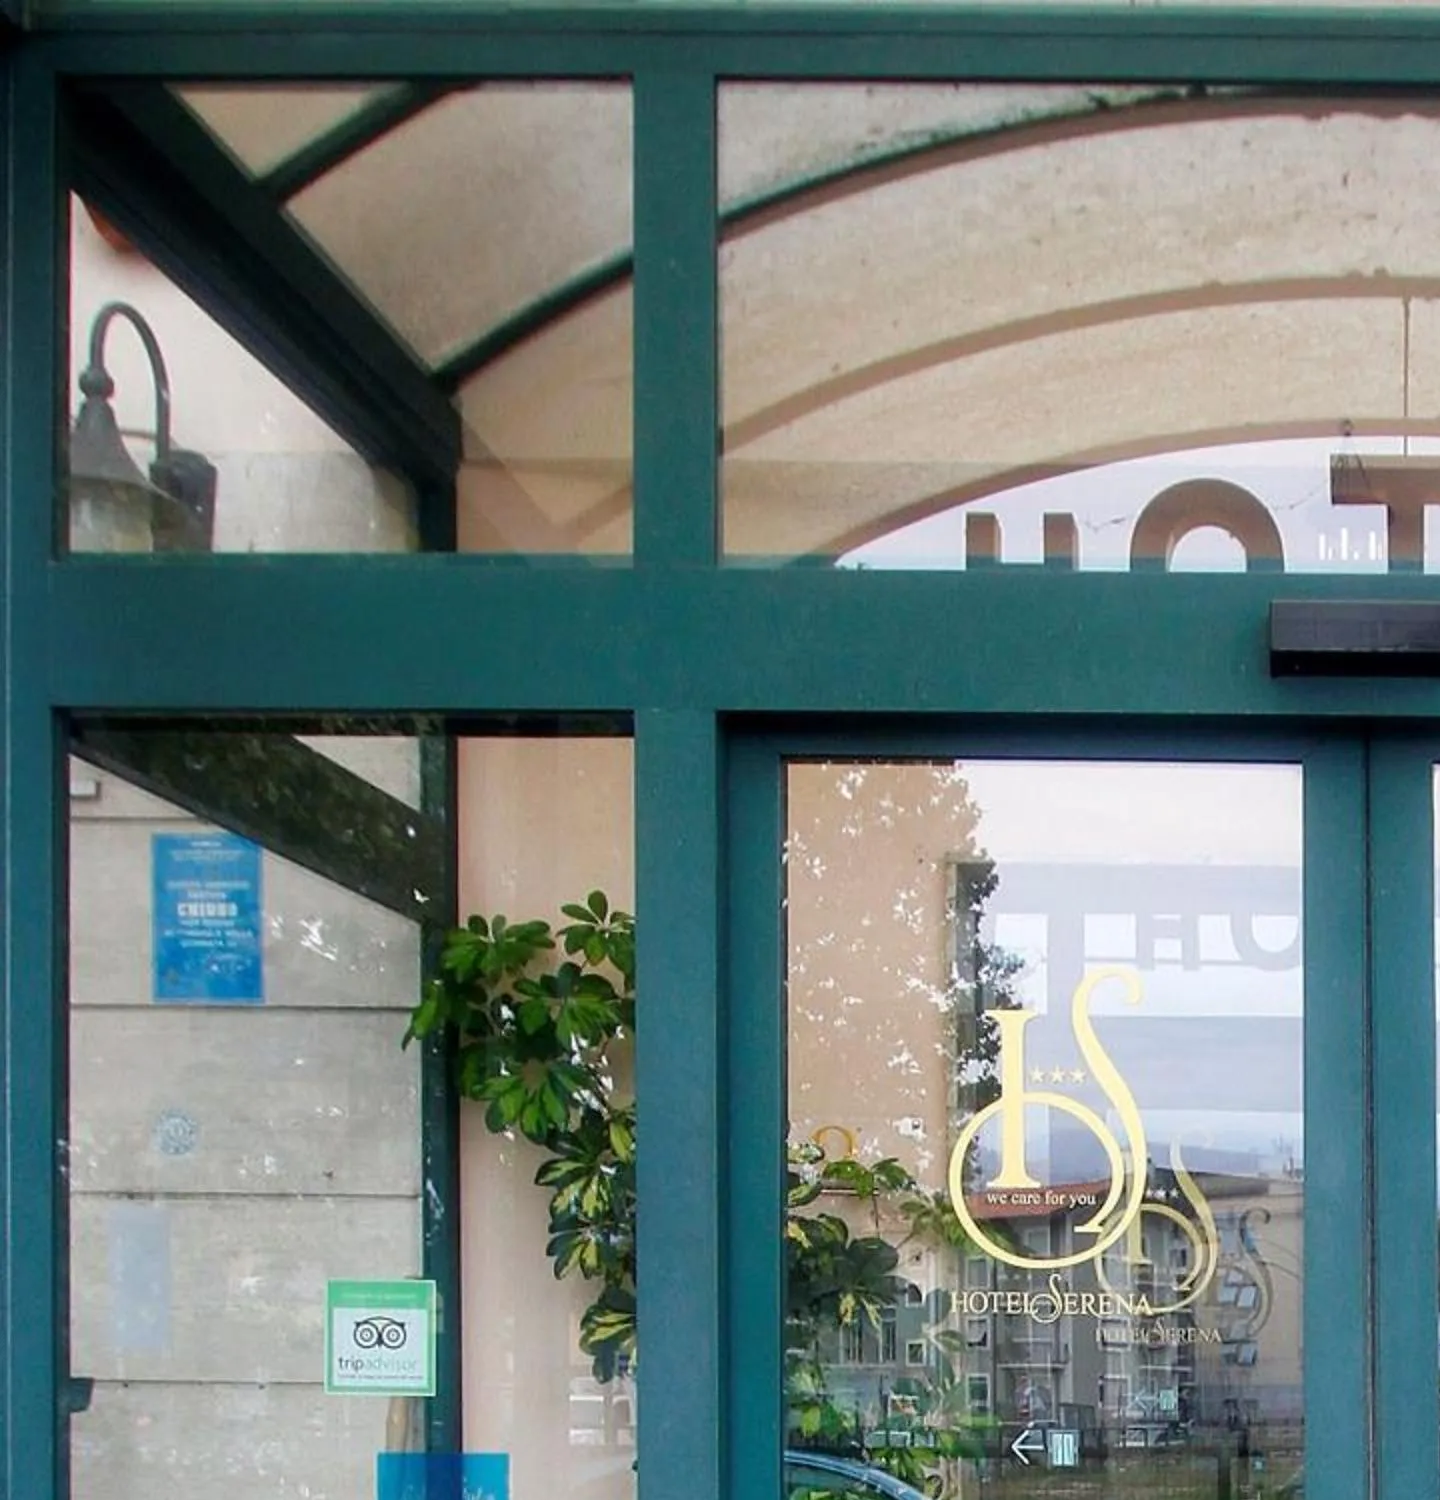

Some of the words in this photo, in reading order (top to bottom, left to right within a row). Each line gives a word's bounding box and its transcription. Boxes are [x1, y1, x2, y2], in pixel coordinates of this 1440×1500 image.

[987, 1193, 1008, 1204] we
[1011, 1193, 1041, 1204] care
[1045, 1190, 1066, 1205] for
[1069, 1193, 1096, 1209] you
[950, 1290, 1036, 1317] HOTEL
[1031, 1273, 1153, 1324] SERENA
[337, 1355, 418, 1373] tripadvisor
